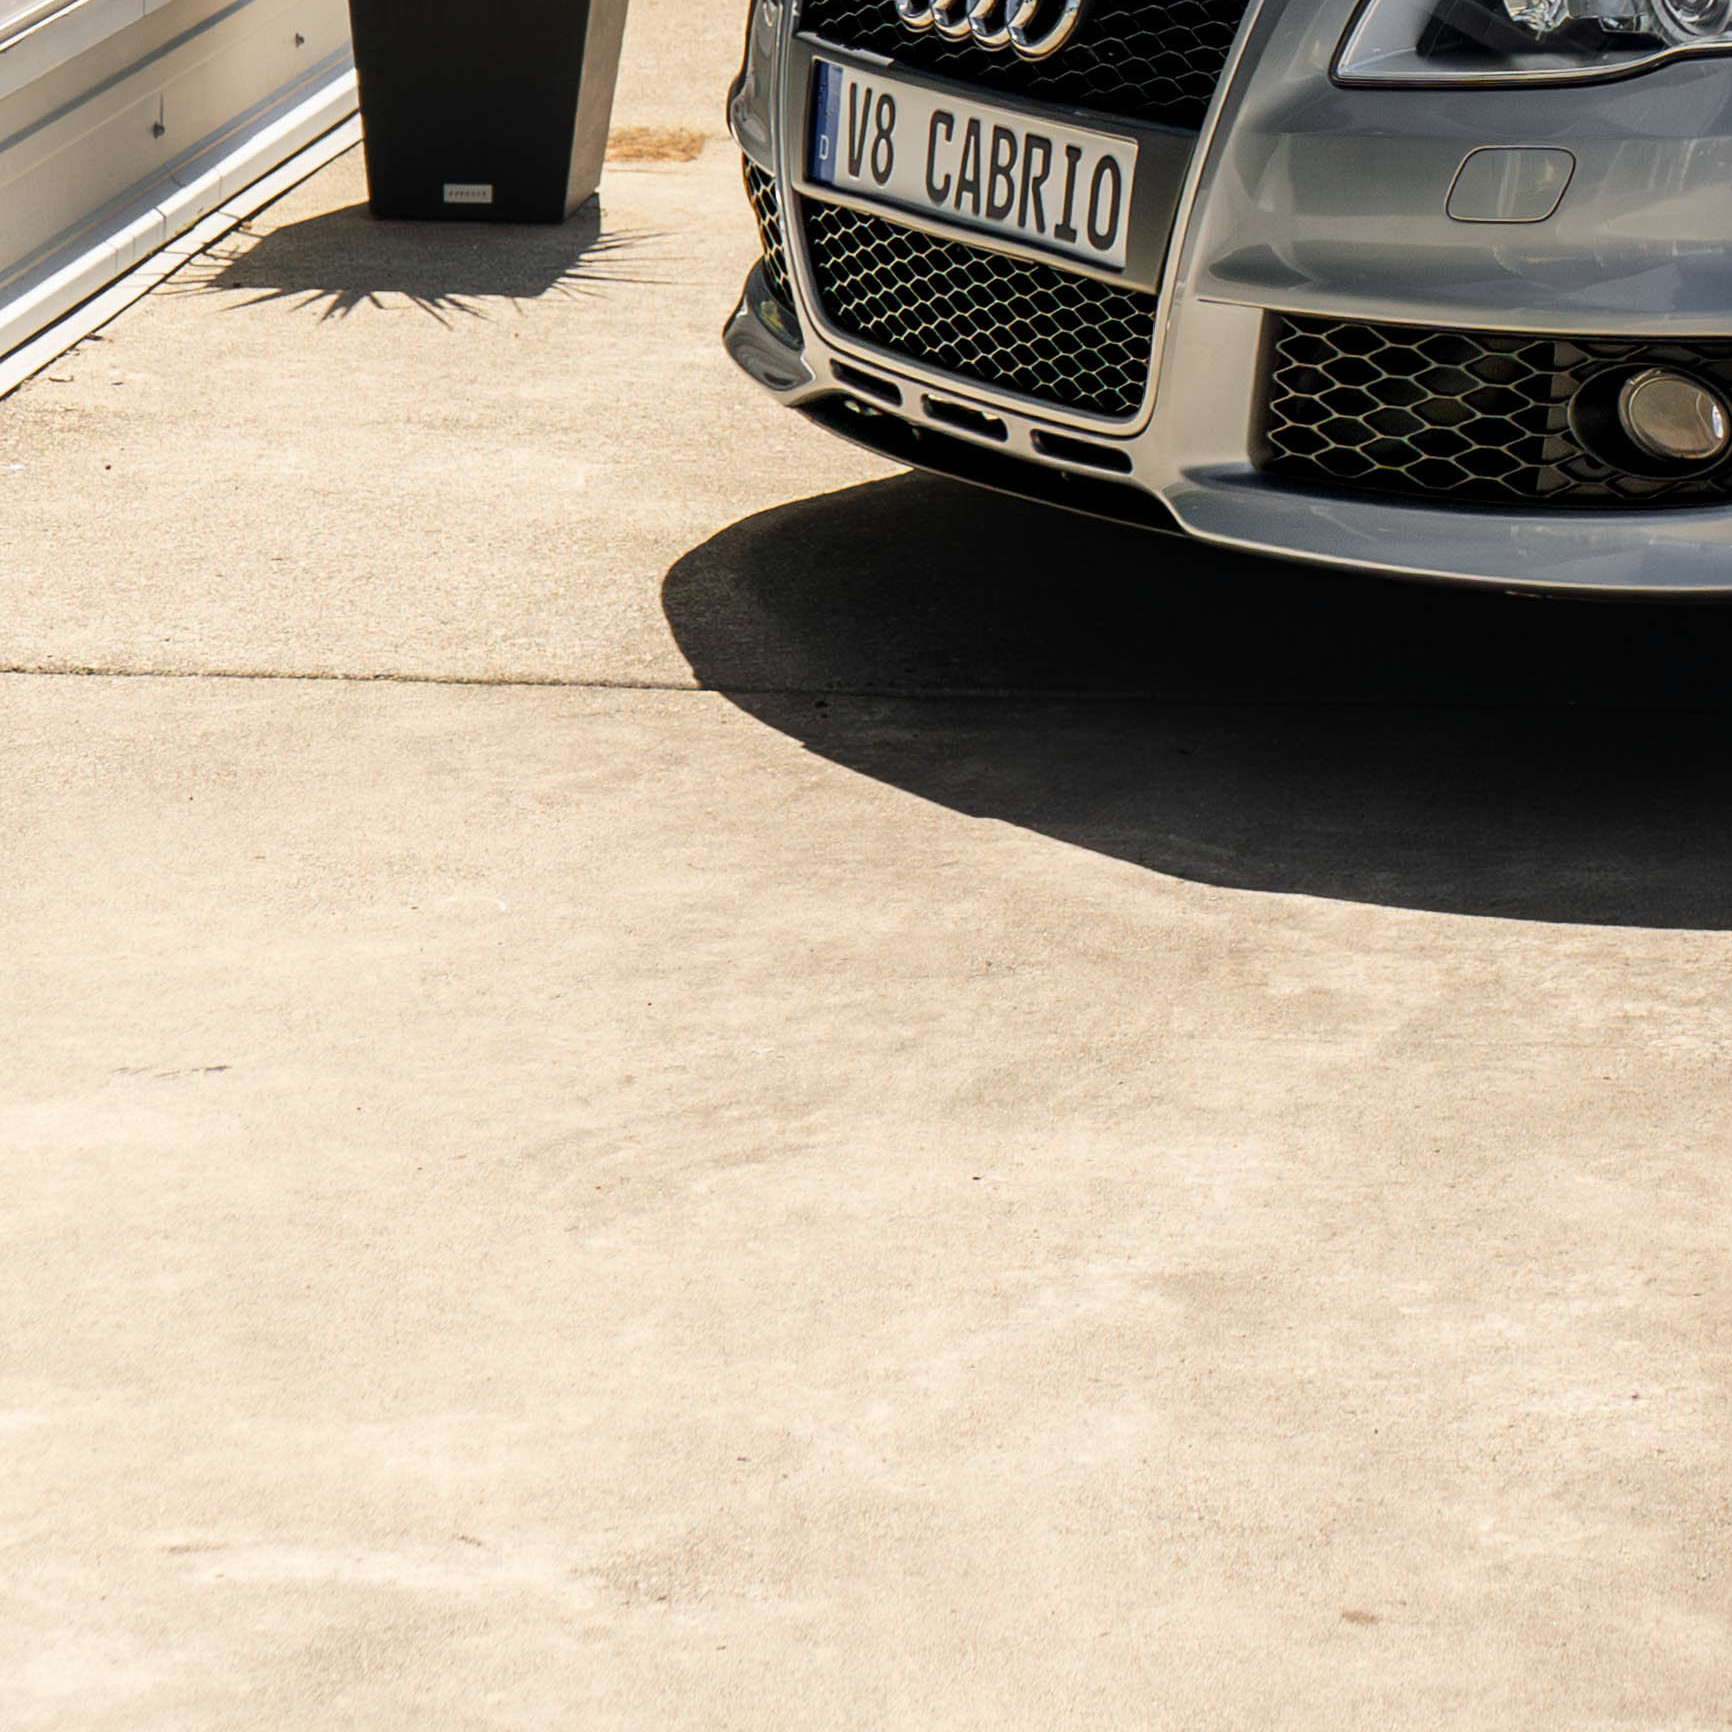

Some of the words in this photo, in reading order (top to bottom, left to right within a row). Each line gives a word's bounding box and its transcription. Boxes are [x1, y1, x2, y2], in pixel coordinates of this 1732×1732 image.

[819, 134, 829, 160] D
[847, 80, 896, 186] V8
[925, 109, 1122, 251] CABRIO
